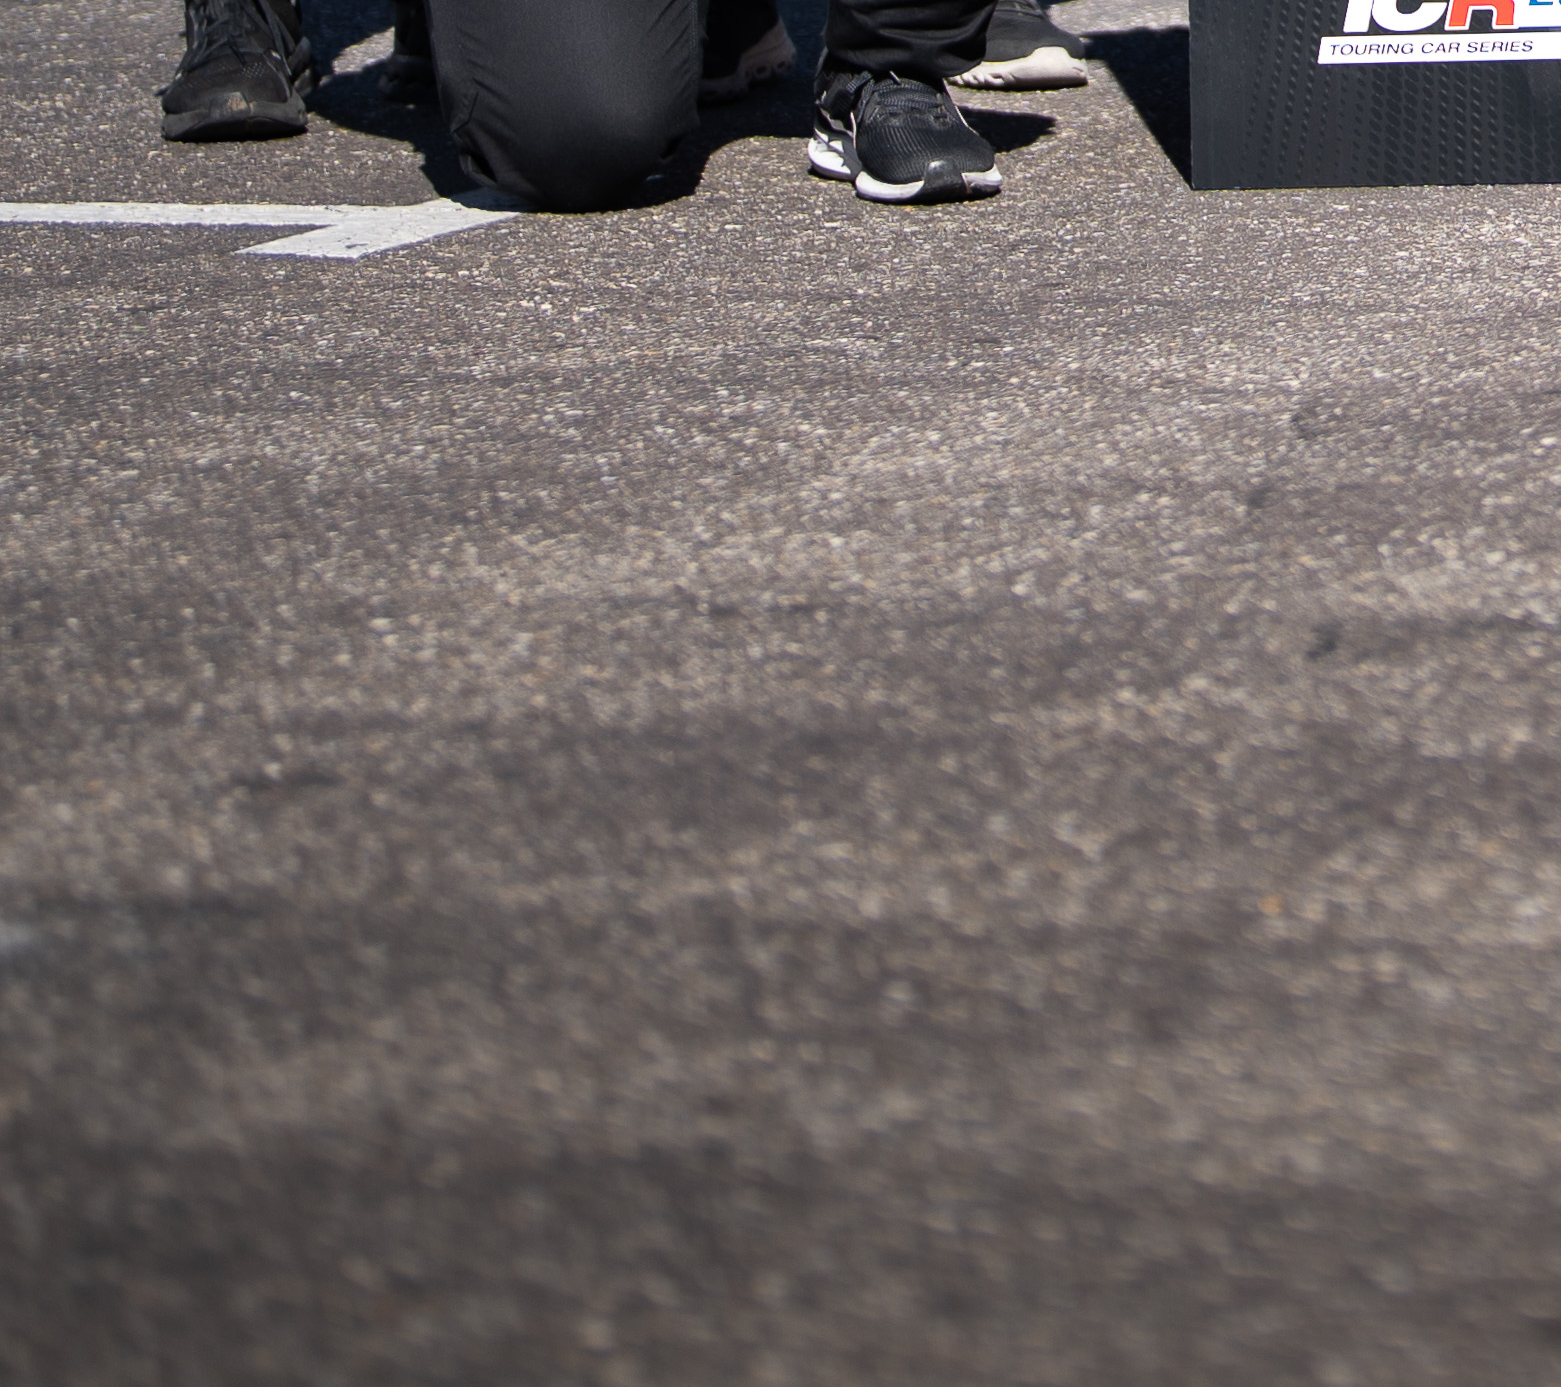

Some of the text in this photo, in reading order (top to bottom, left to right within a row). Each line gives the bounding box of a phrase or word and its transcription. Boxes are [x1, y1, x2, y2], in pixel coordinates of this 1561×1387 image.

[1330, 40, 1534, 57] TOURING CAR SERIES
